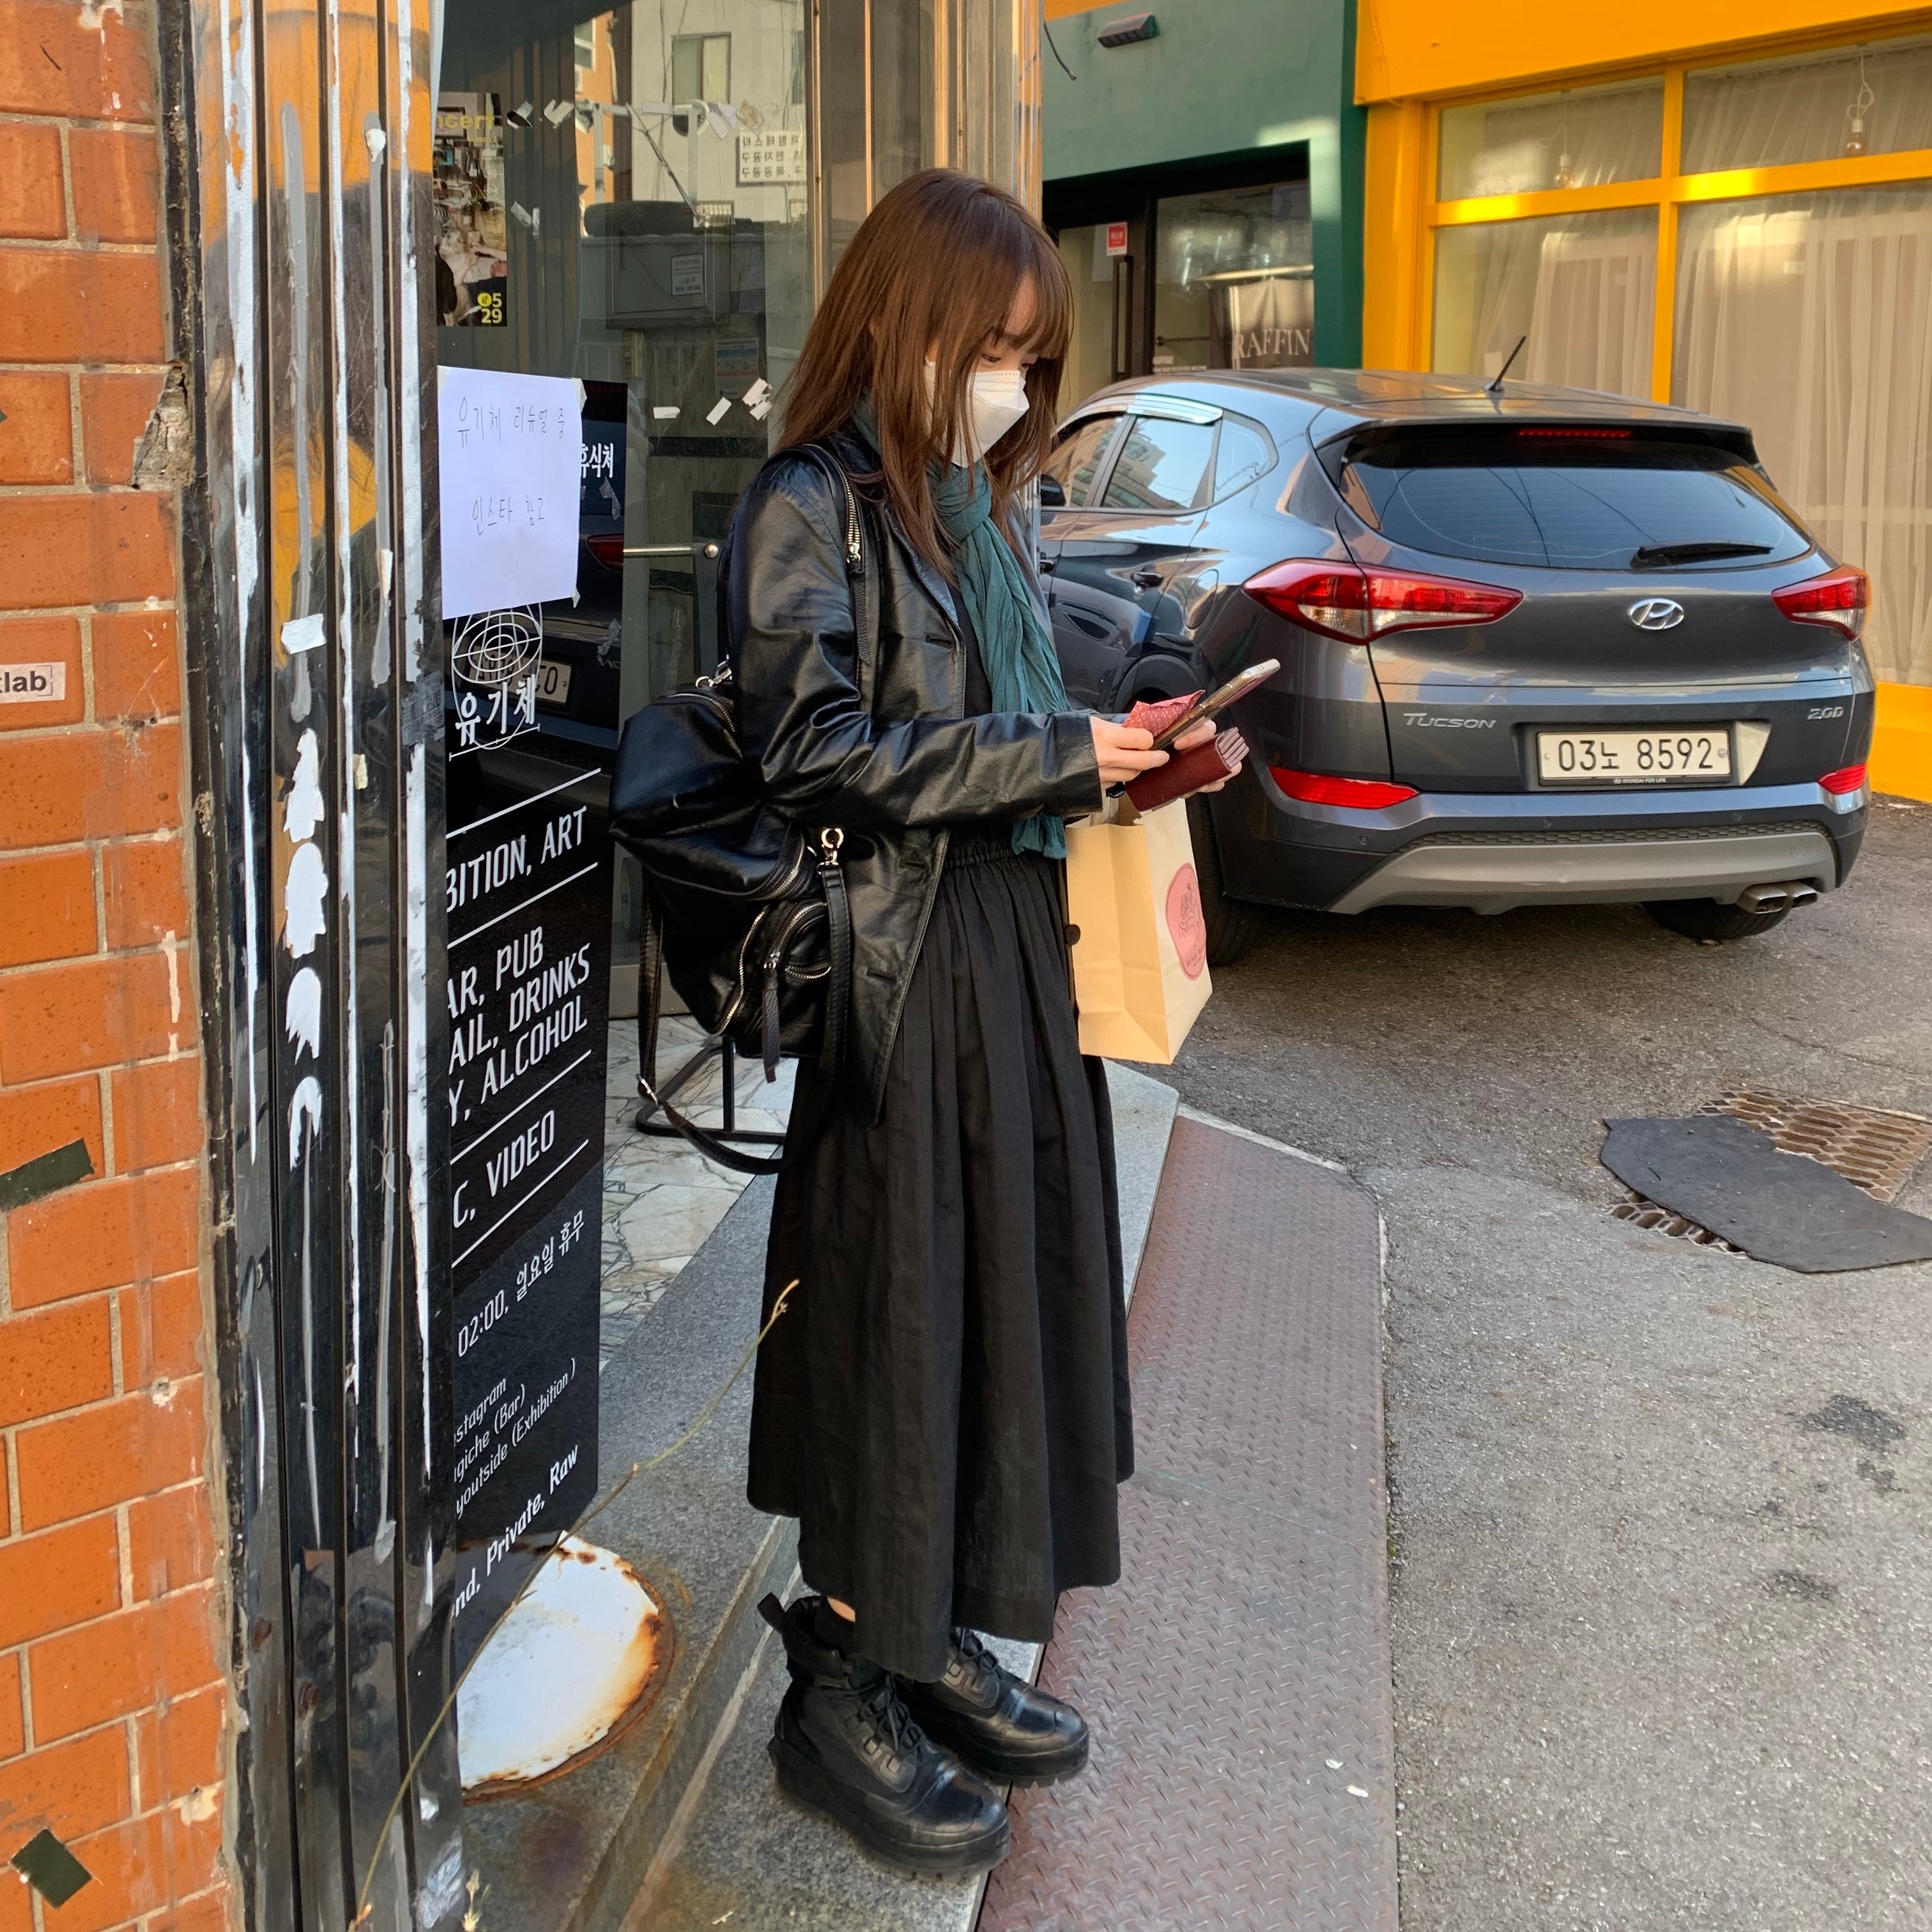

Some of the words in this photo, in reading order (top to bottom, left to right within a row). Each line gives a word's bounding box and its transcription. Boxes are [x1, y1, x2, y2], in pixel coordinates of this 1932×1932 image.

[481, 308, 502, 324] 29
[457, 396, 502, 448] 유기체
[514, 403, 548, 434] 리뉴얼
[557, 408, 565, 440] 중
[472, 496, 513, 535] 인스타
[525, 494, 546, 526] 참고
[0, 671, 47, 693] lab
[455, 673, 536, 747] 유기체
[1403, 712, 1497, 729] TUCSON
[1558, 739, 1620, 772] 03노
[1636, 737, 1714, 770] 8592
[540, 806, 588, 864] ART
[495, 926, 544, 992] PUB
[448, 1013, 499, 1075] AIL,
[509, 942, 590, 1031] DRINKS
[480, 995, 588, 1105] ALCOHOL
[453, 1180, 476, 1229] C,
[486, 1110, 556, 1198] VIDEO
[457, 1289, 509, 1358] 02:00,
[516, 1236, 555, 1303] 일요일
[558, 1209, 585, 1257] 휴무
[494, 1383, 525, 1435] (Bar)
[456, 1443, 509, 1521] youtside
[486, 1490, 545, 1578] Private,
[549, 1444, 579, 1496] Raw
